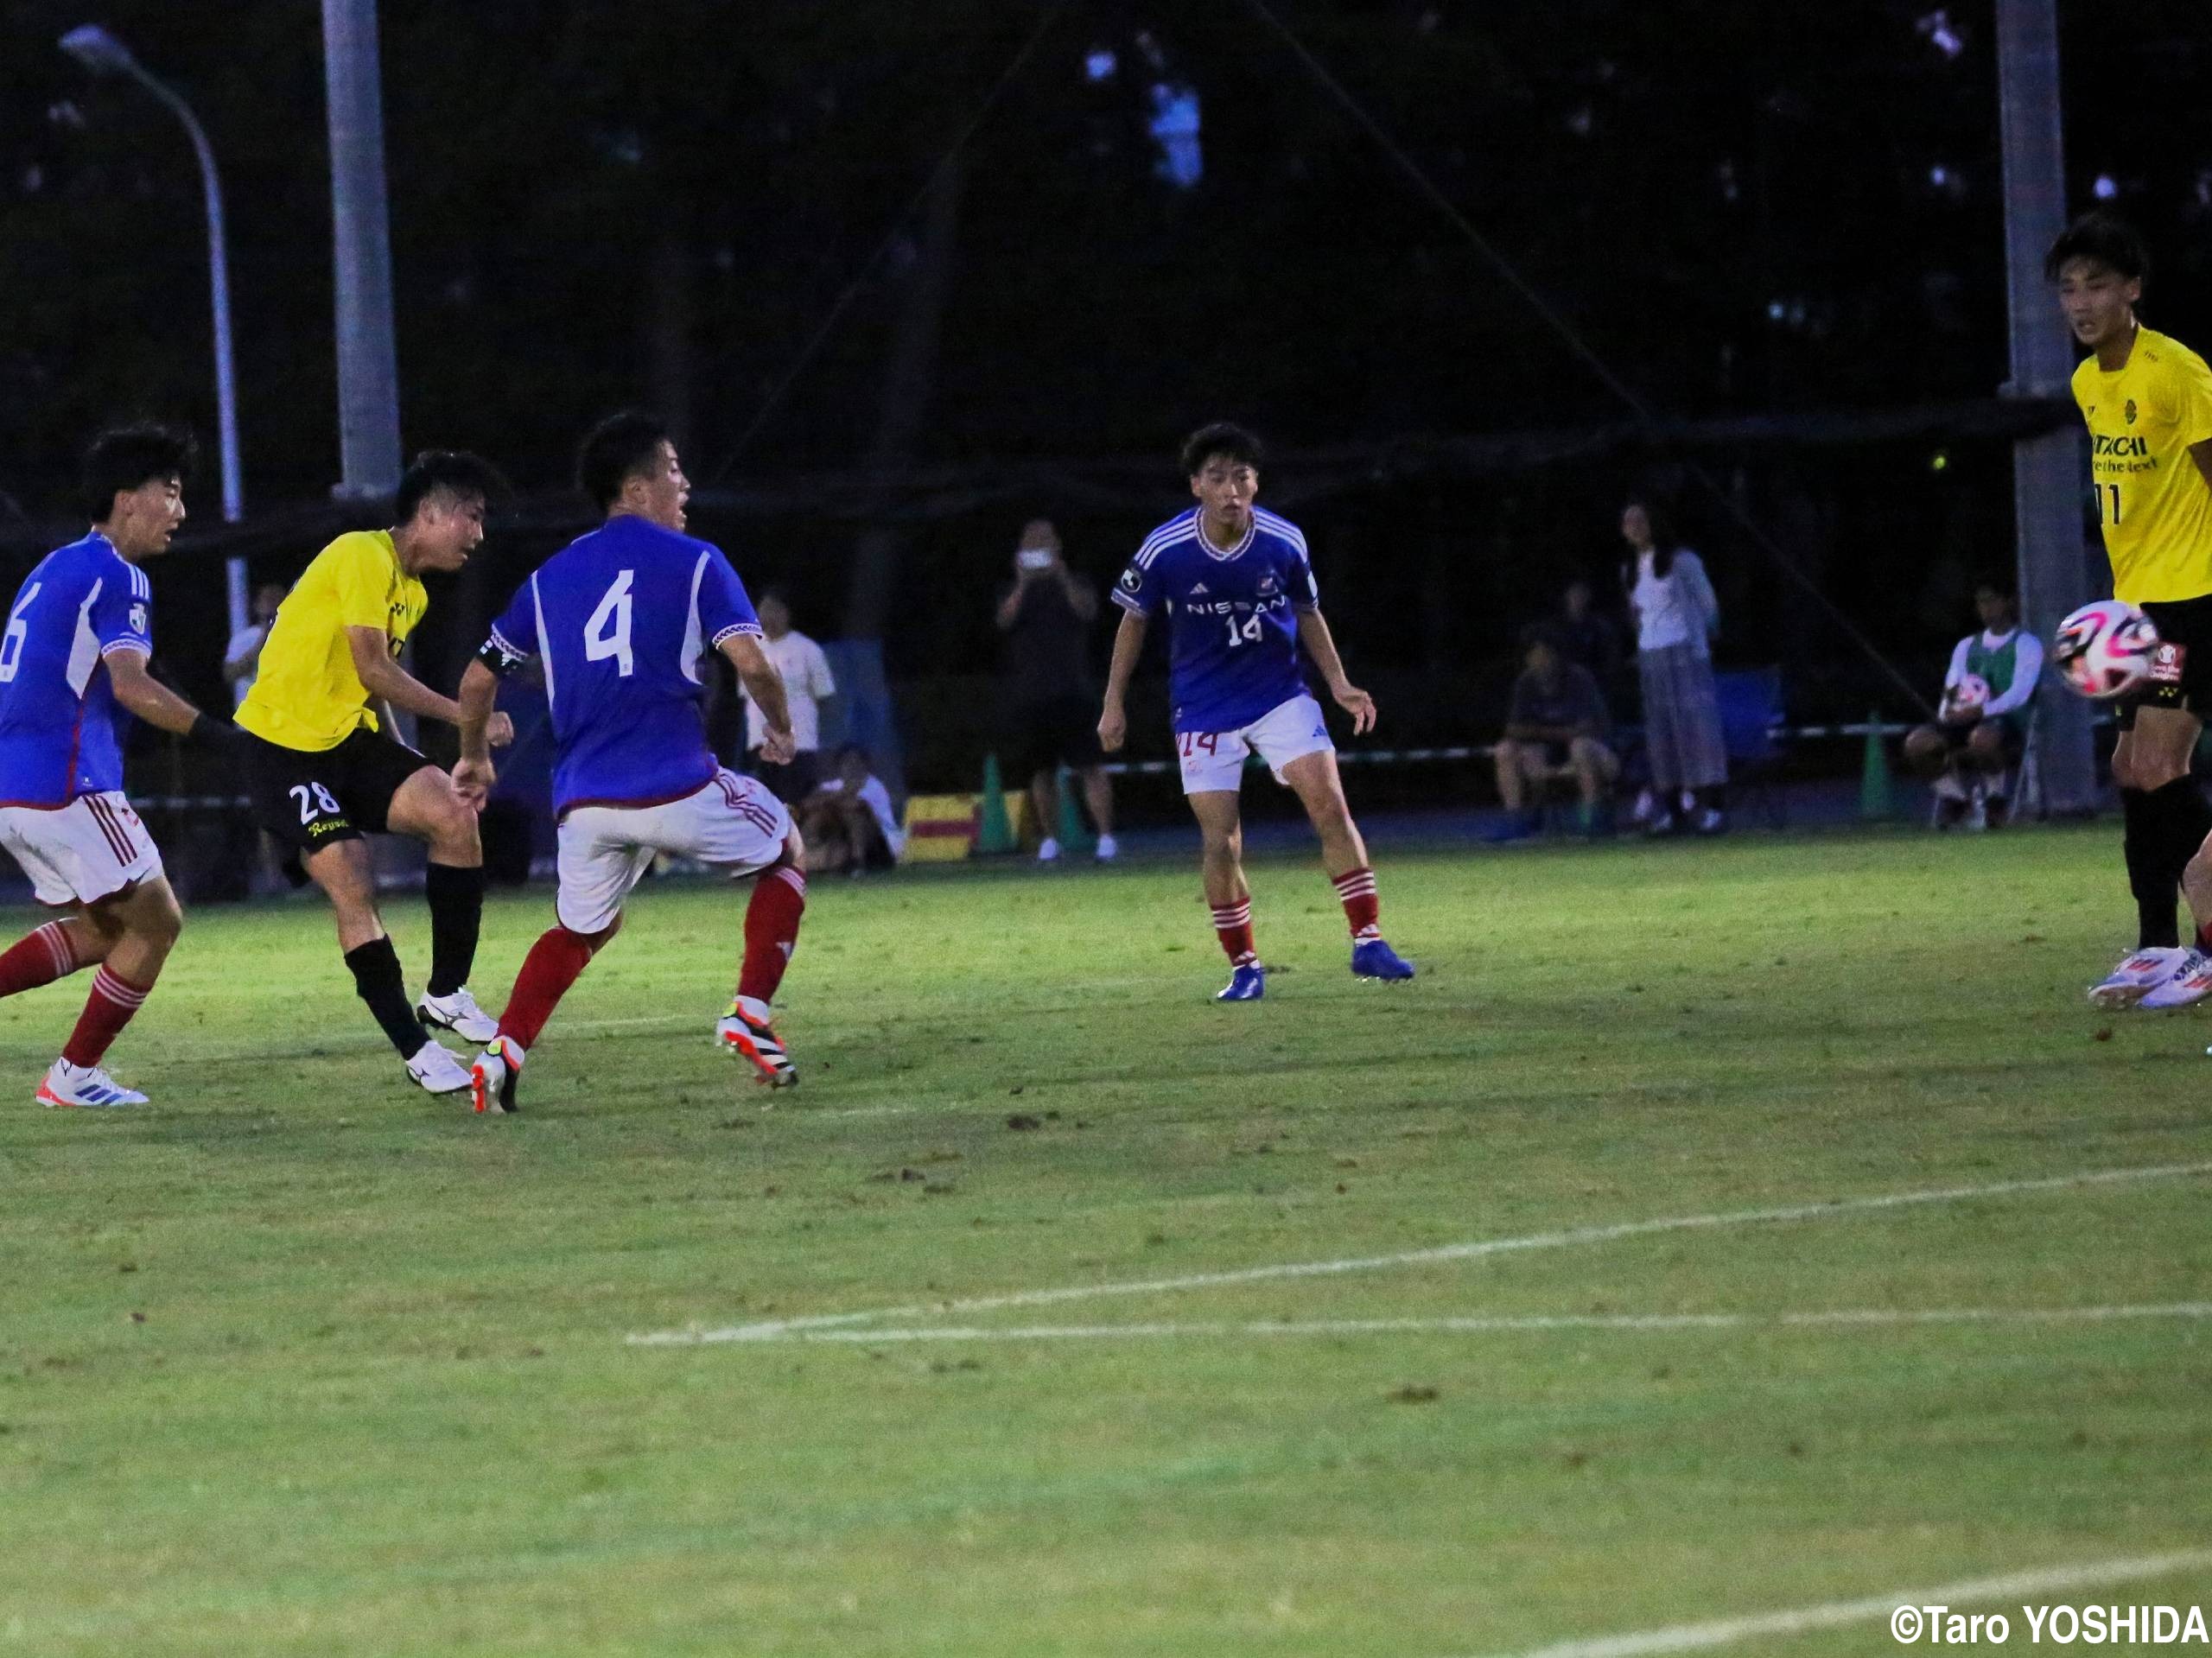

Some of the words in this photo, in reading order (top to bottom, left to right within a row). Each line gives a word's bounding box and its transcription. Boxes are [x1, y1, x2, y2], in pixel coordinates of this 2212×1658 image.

[0, 582, 41, 683] 6
[584, 569, 634, 677] 4
[1226, 614, 1262, 647] 14
[1184, 732, 1217, 757] 14
[289, 781, 340, 825] 28
